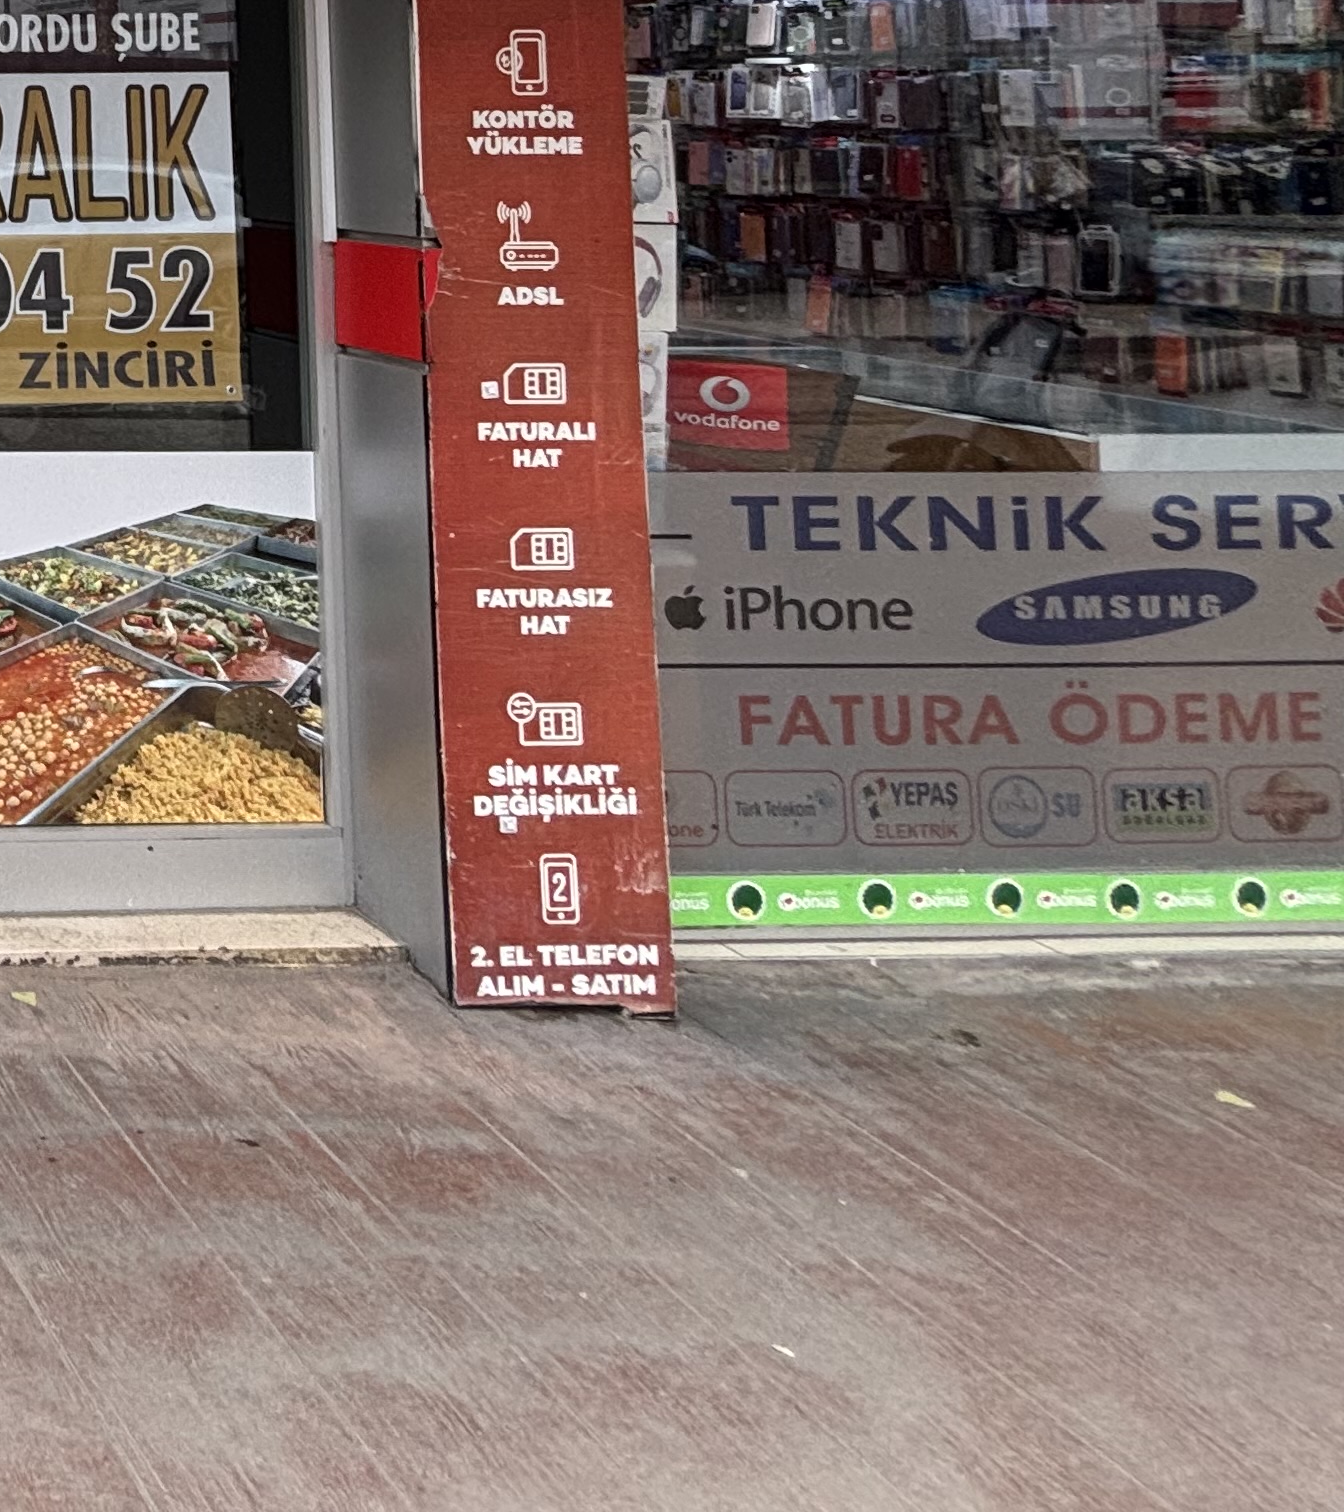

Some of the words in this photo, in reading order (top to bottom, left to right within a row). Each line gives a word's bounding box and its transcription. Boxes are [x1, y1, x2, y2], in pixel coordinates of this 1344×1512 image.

[113, 13, 200, 62] ŞUBE
[472, 104, 575, 129] KONTÖR
[466, 130, 583, 156] YÜKLEME
[106, 246, 217, 335] 52
[497, 286, 565, 307] ADSL
[18, 339, 218, 390] ZİNCİRİ
[477, 422, 597, 442] FATURALI
[673, 411, 781, 432] vodafone
[512, 448, 563, 468] HAT
[1151, 494, 1344, 552] SER
[476, 587, 613, 609] FATURASIZ
[725, 585, 913, 631] iPhone
[1013, 593, 1222, 620] SAMSUNG
[520, 615, 571, 636] HAT
[738, 694, 1021, 748] FATURA
[1048, 681, 1323, 745] ÖDEME
[488, 758, 537, 787] SİM
[544, 763, 620, 786] KART
[473, 786, 638, 823] DEĞİŞİKLİĞİ
[889, 781, 959, 810] YEPAŞ
[470, 945, 495, 968] 2.
[499, 945, 533, 967] EL
[537, 944, 660, 967] TELEFON
[477, 975, 545, 997] ALIM
[571, 973, 657, 997] SATIM
